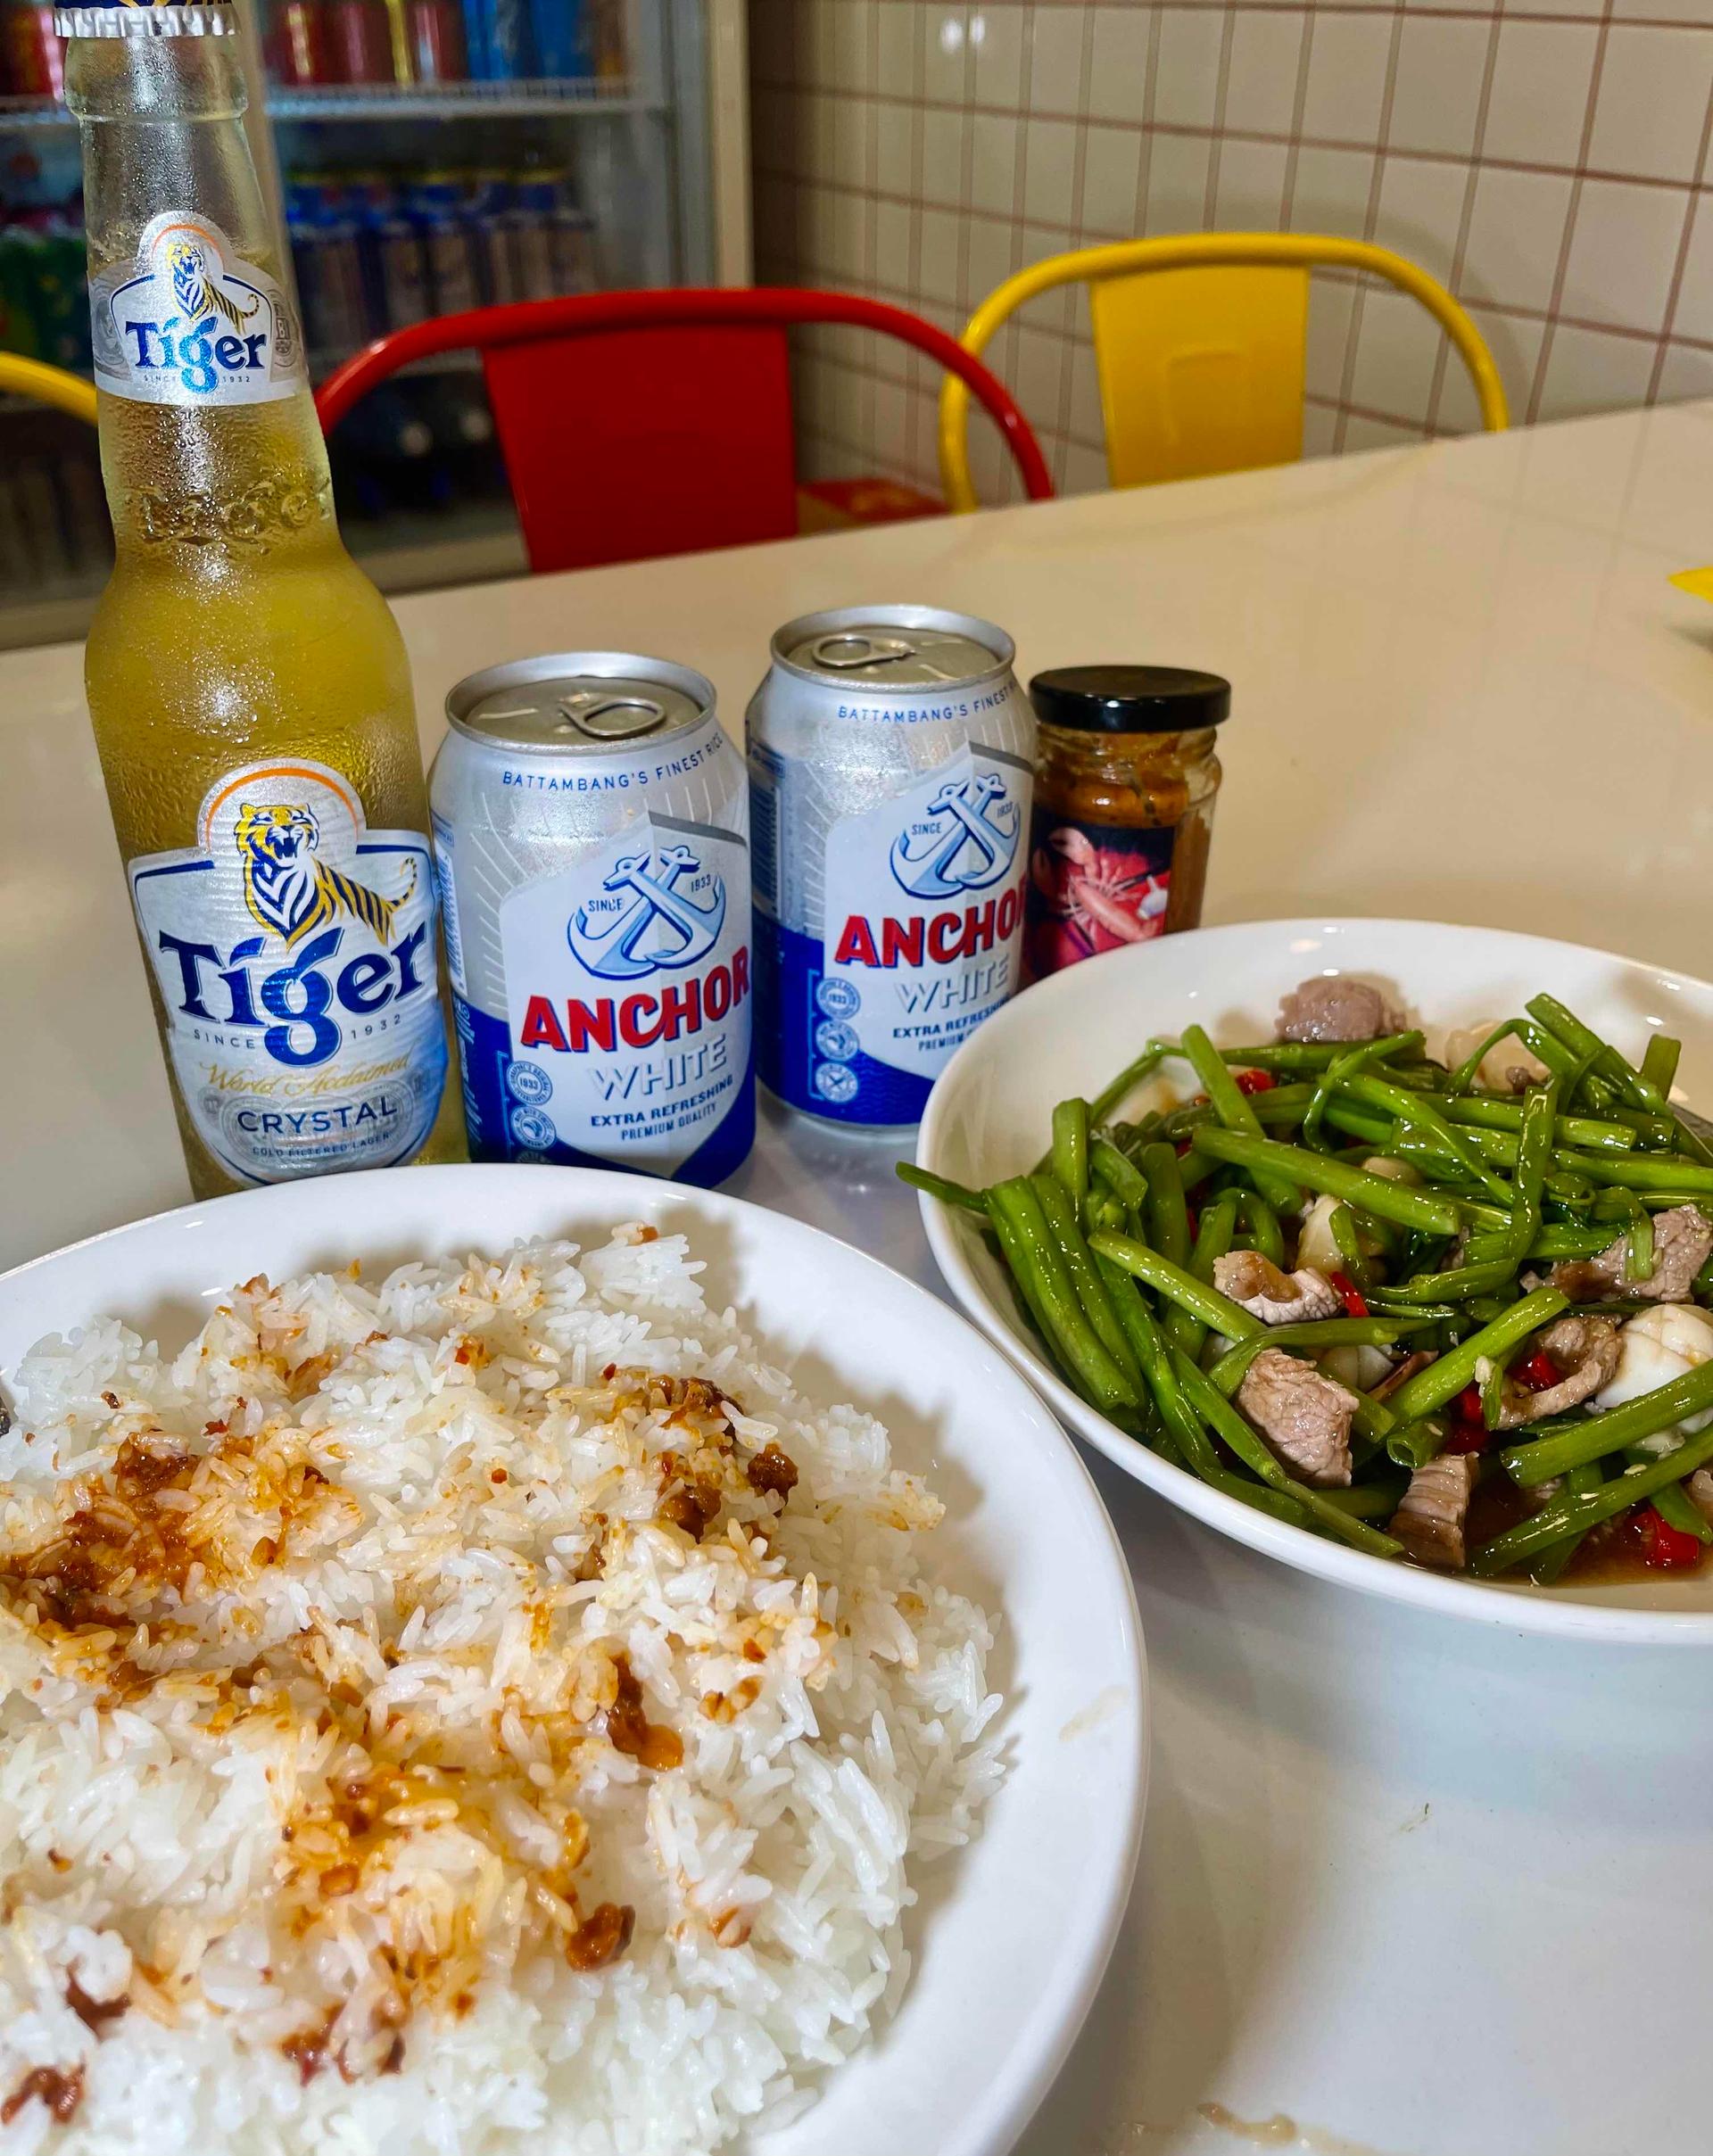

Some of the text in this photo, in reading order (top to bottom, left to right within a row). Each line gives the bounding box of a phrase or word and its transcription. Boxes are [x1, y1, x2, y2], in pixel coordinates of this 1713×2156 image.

[125, 316, 267, 394] Tiger
[837, 705, 968, 723] BATTAMBANG'S
[502, 771, 649, 791] BATTAMBANG'S
[656, 750, 705, 780] FINEST
[911, 822, 941, 836] SINCE
[691, 874, 712, 892] 1933
[588, 897, 624, 913] SINCE
[159, 921, 427, 1069] Tiger
[520, 946, 750, 1053] ANCHOR
[893, 954, 1009, 1014] WHITE
[194, 1013, 401, 1050] SINCE 1932
[893, 1025, 940, 1038] EXTRA
[918, 1034, 969, 1052] PREMIUM
[199, 1061, 279, 1095] World
[588, 1033, 727, 1101] WHITE
[237, 1095, 398, 1135] CRYSTAL
[591, 1074, 733, 1127] EXTRA REFRESHING
[621, 1103, 716, 1141] PREMIUM QUALITY
